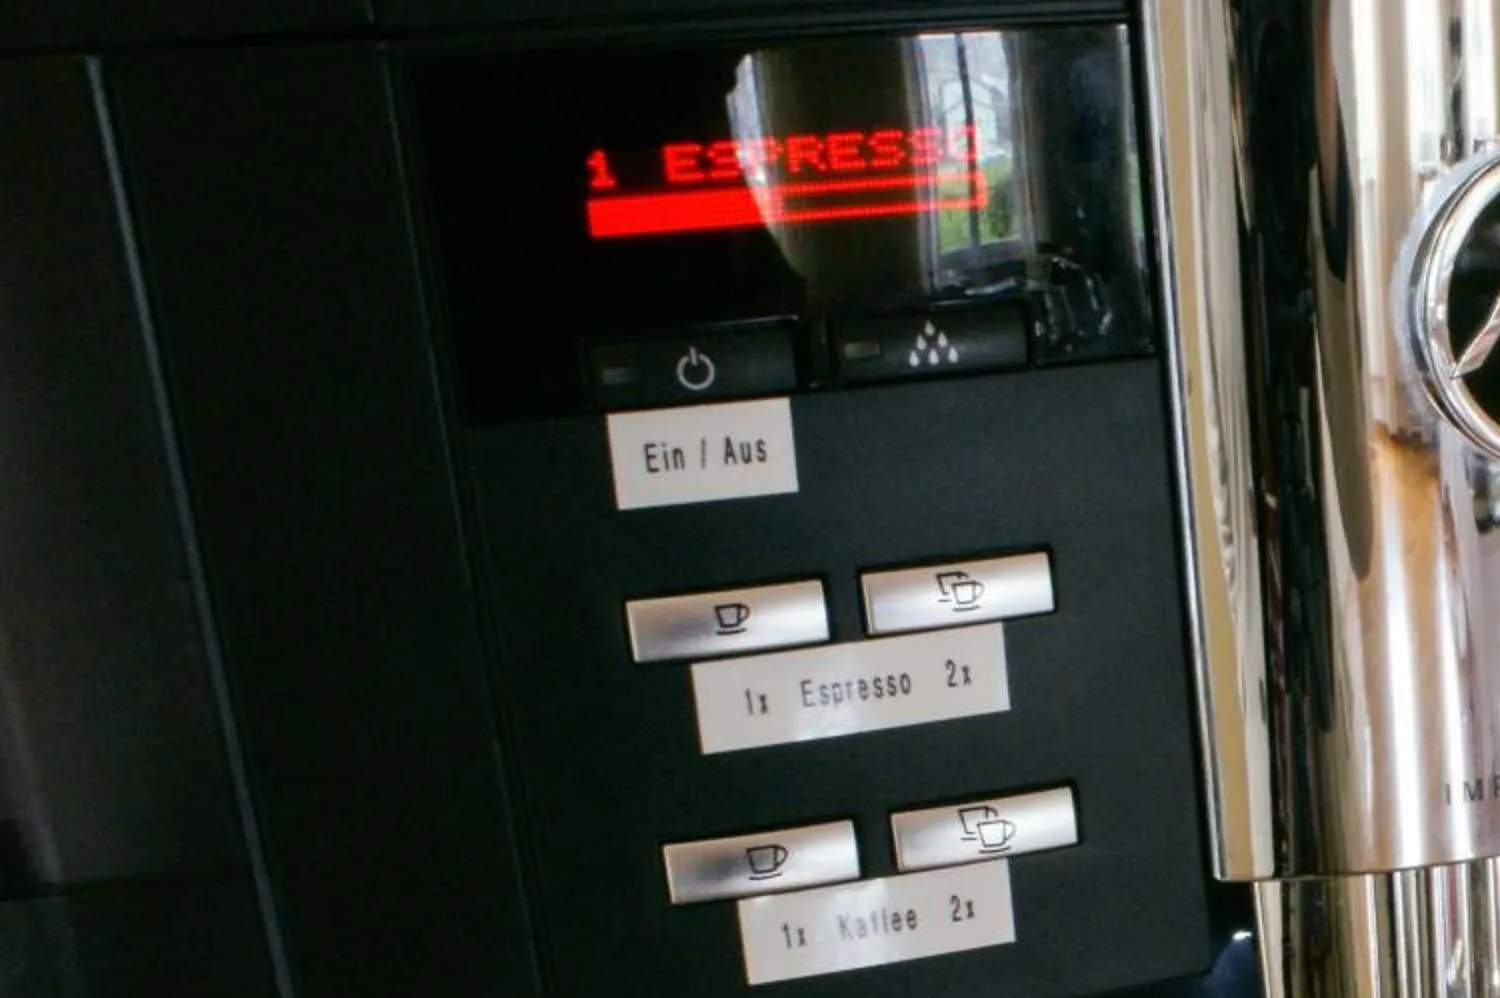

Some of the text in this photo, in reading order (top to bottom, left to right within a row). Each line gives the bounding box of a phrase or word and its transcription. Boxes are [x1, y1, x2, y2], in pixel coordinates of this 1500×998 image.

[586, 124, 979, 190] 1 ESPRESSO
[643, 441, 686, 474] Ein
[723, 435, 768, 466] Aus
[744, 658, 974, 716] 1x Espresso 2x
[782, 894, 976, 950] 1x Kaffee 2x
